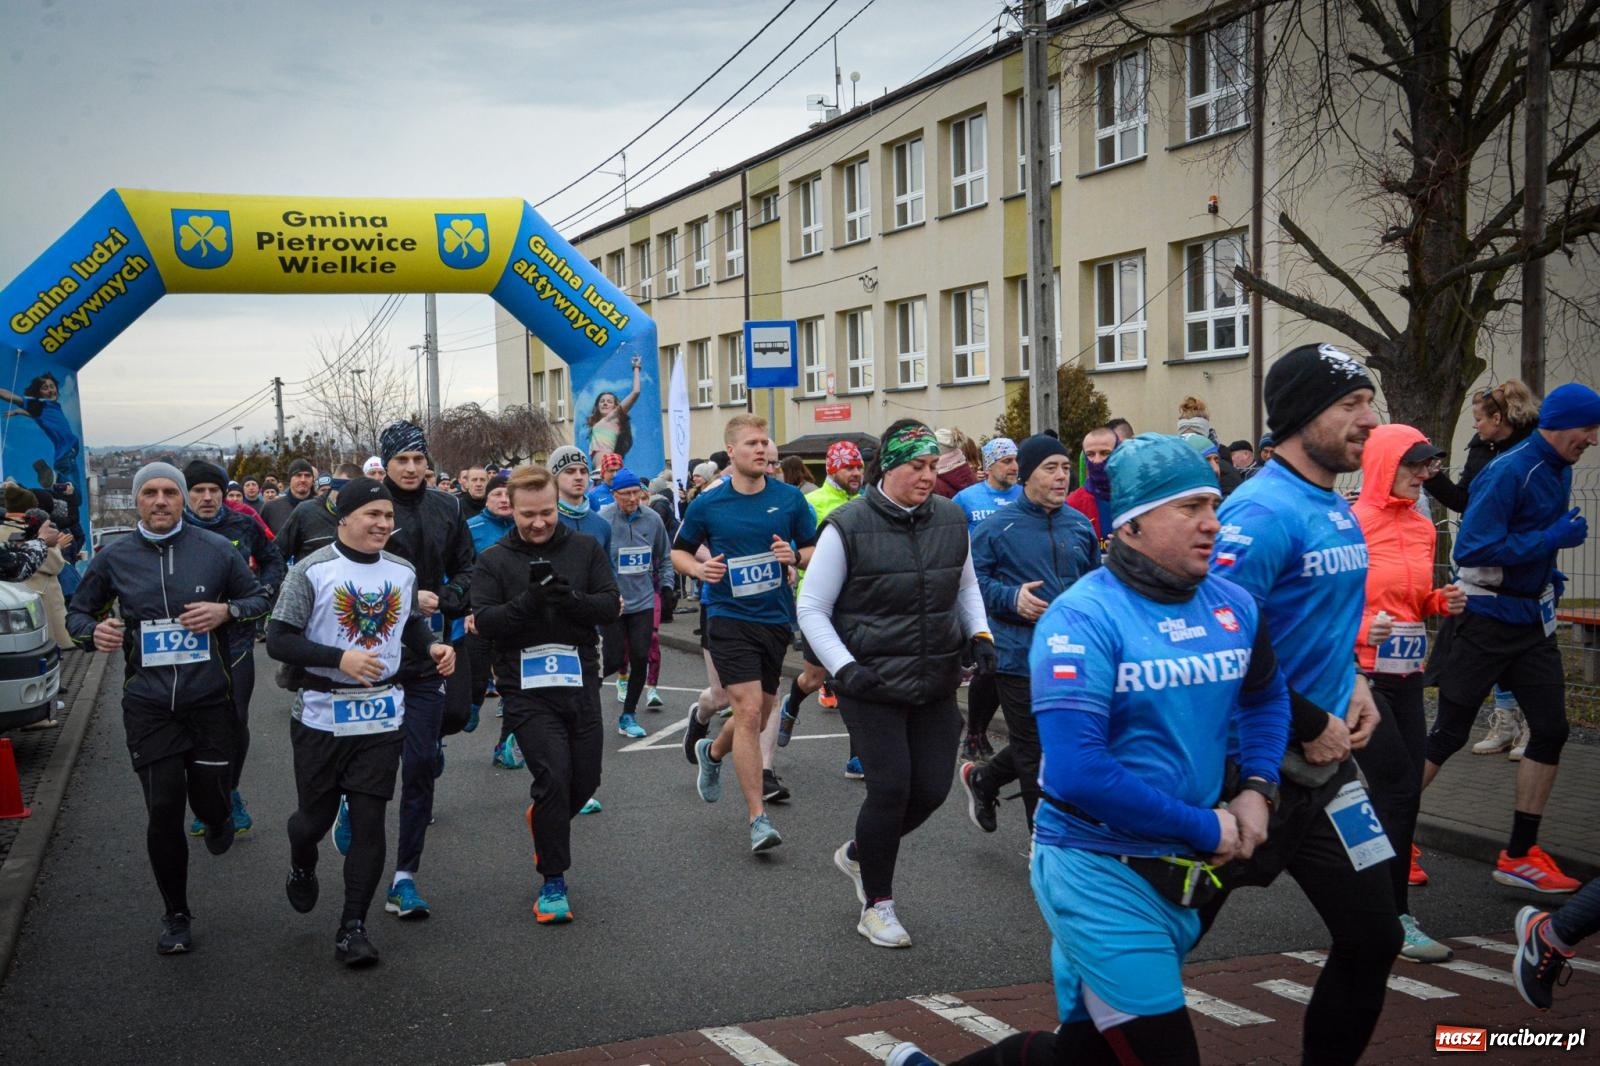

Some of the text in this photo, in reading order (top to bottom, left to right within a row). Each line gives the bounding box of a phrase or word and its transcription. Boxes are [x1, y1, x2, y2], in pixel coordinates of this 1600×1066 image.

[282, 210, 388, 228] Gmina
[256, 231, 417, 251] Pietrowice
[278, 256, 397, 274] Wielkie
[10, 227, 129, 334] Gmina ludzi
[528, 234, 630, 330] Gmina ludzi
[40, 254, 150, 353] aktywnych
[513, 258, 610, 347] aktywnych
[628, 554, 643, 566] 51
[740, 563, 774, 584] 104
[155, 631, 199, 652] 196
[1390, 636, 1421, 657] 172
[544, 655, 559, 673] 8
[346, 698, 388, 721] 102
[1361, 802, 1383, 833] 3
